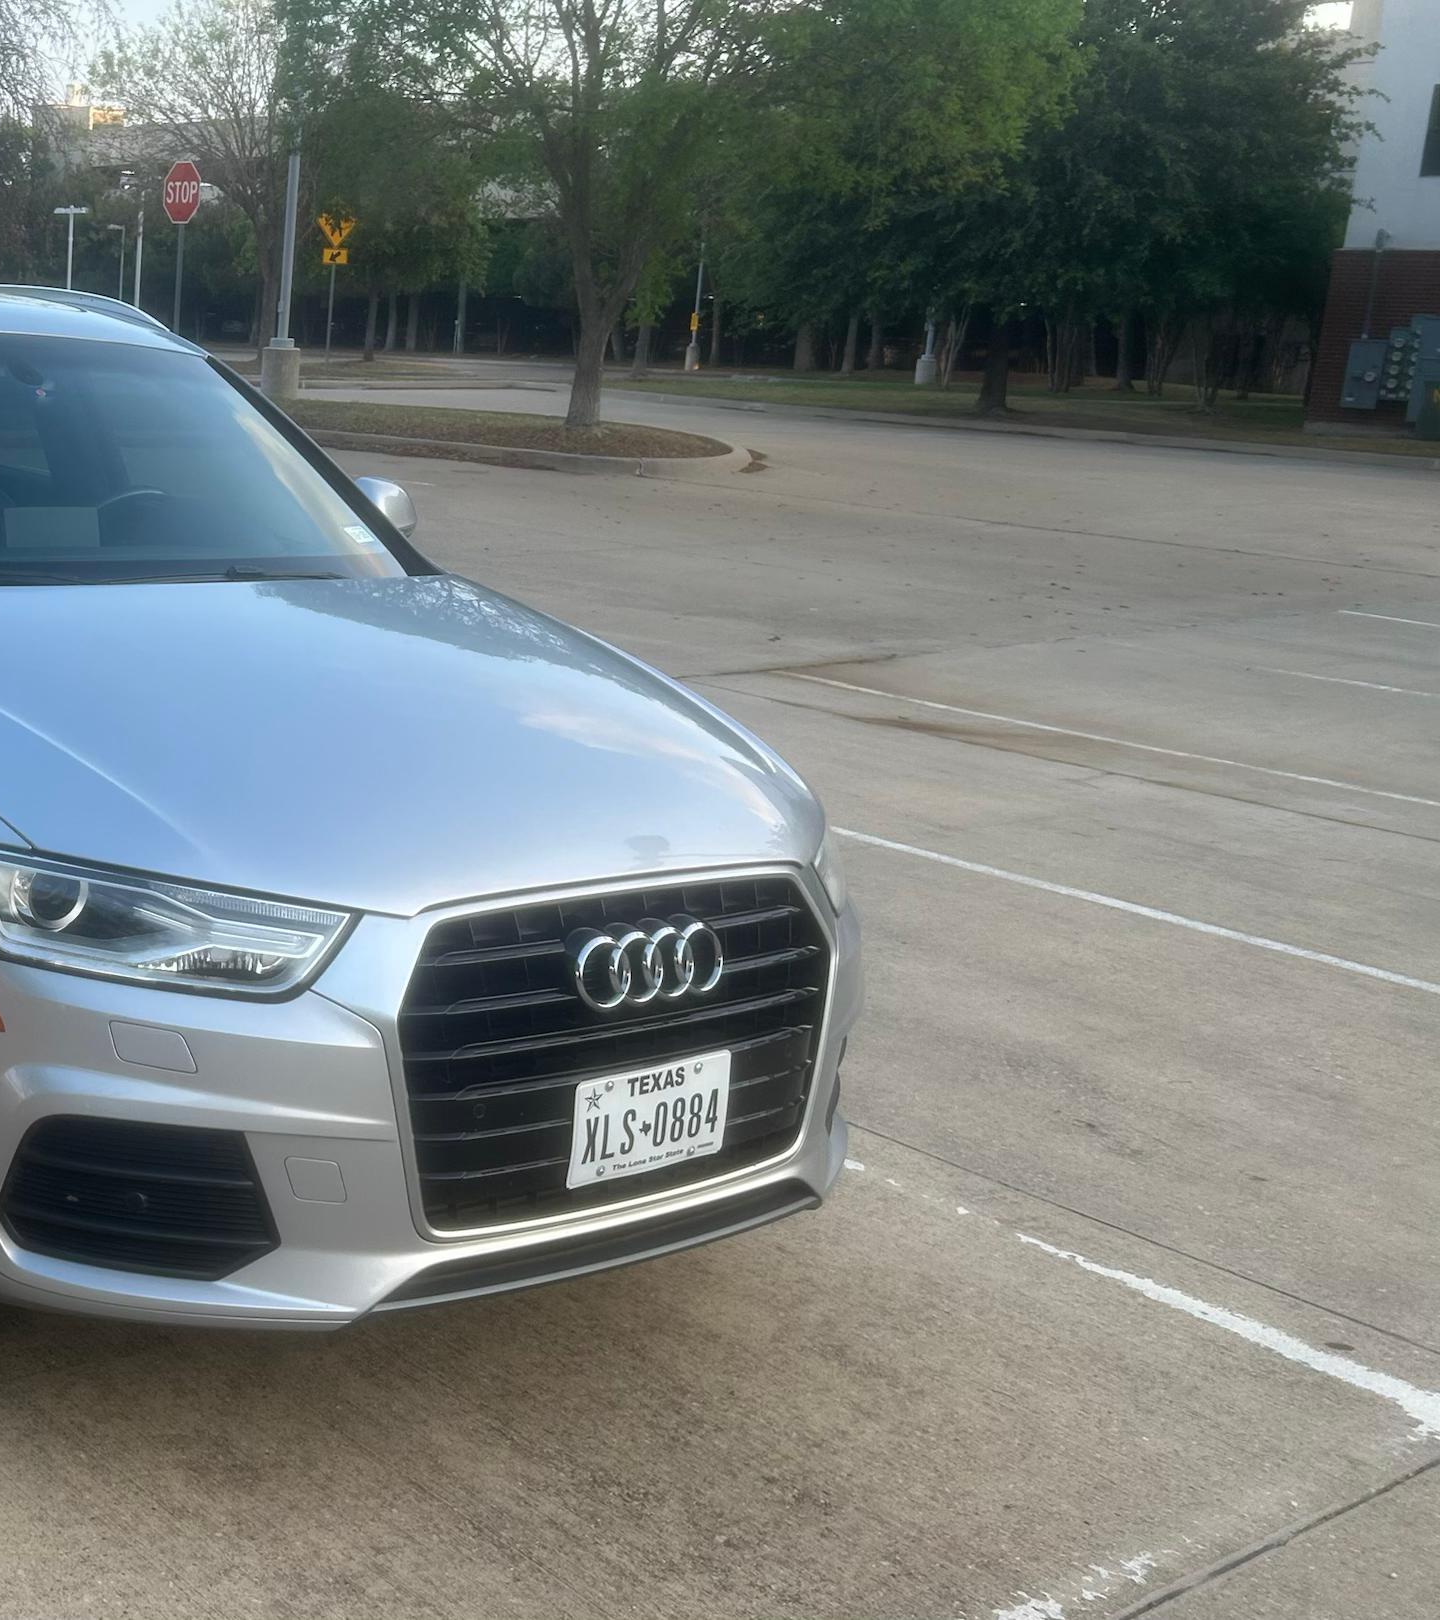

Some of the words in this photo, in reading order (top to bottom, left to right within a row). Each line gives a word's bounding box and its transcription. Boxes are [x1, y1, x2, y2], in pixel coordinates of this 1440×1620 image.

[166, 181, 198, 204] STOP
[627, 1066, 685, 1097] TEXAS
[612, 1163, 626, 1171] The
[628, 1158, 647, 1168] Lone
[648, 1154, 664, 1163] Star
[665, 1148, 684, 1158] State
